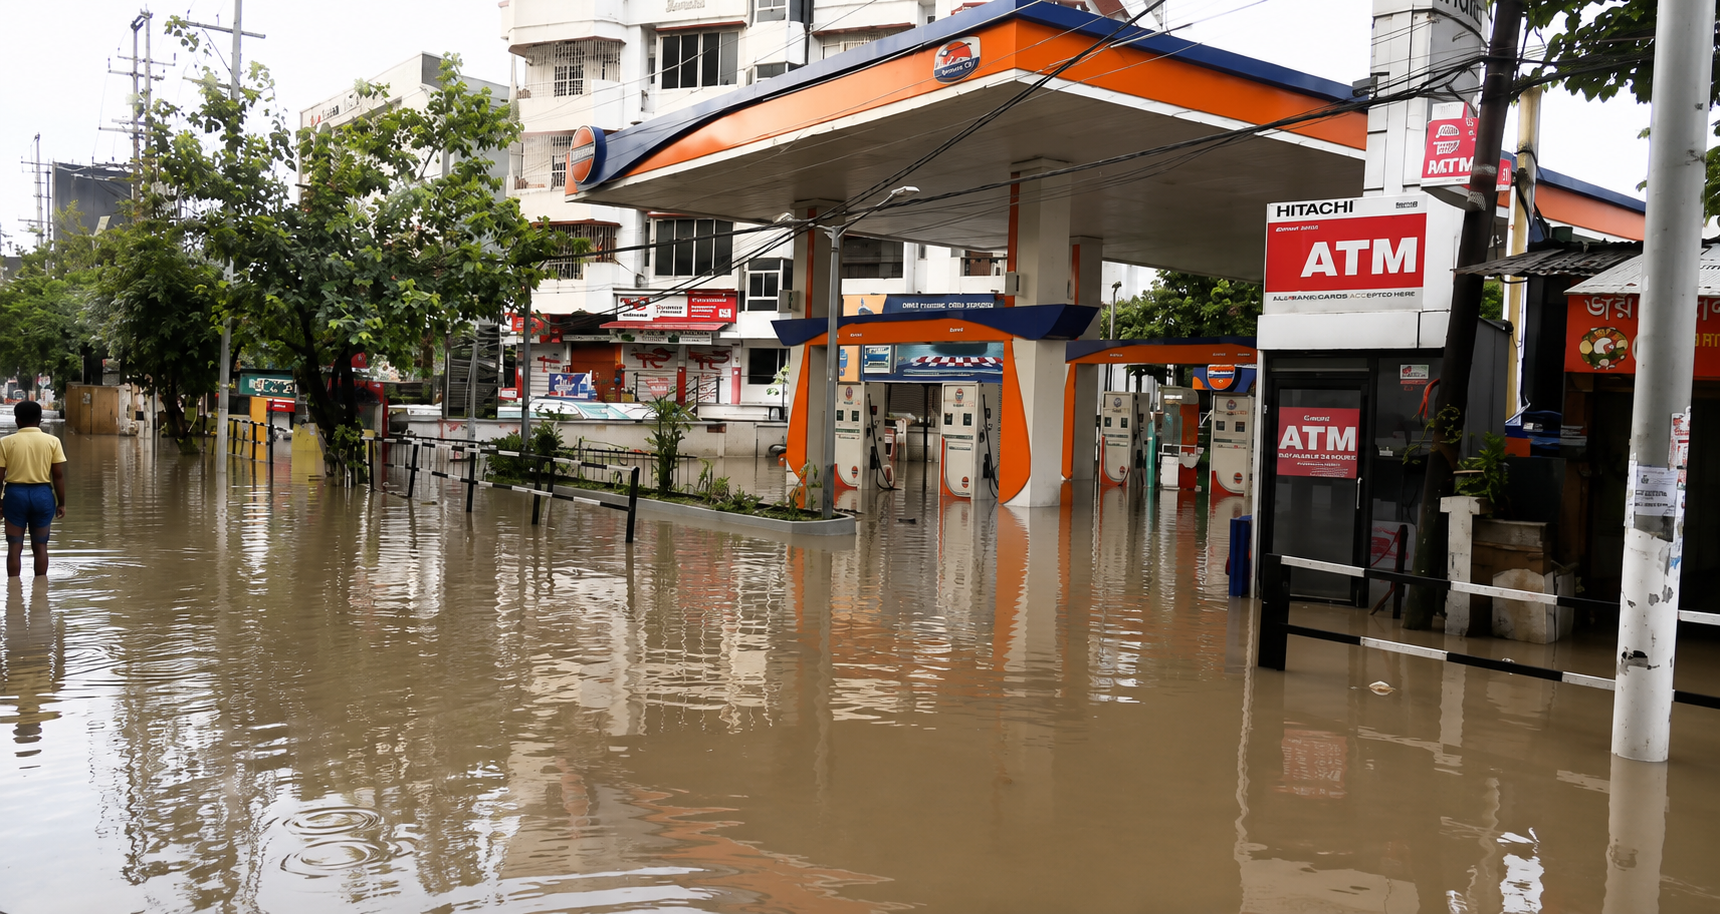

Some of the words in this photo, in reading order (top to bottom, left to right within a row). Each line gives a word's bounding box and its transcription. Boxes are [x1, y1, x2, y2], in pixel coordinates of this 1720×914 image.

[1276, 200, 1354, 217] HITACHI
[1300, 236, 1418, 278] ATM
[1278, 425, 1357, 452] ATM
